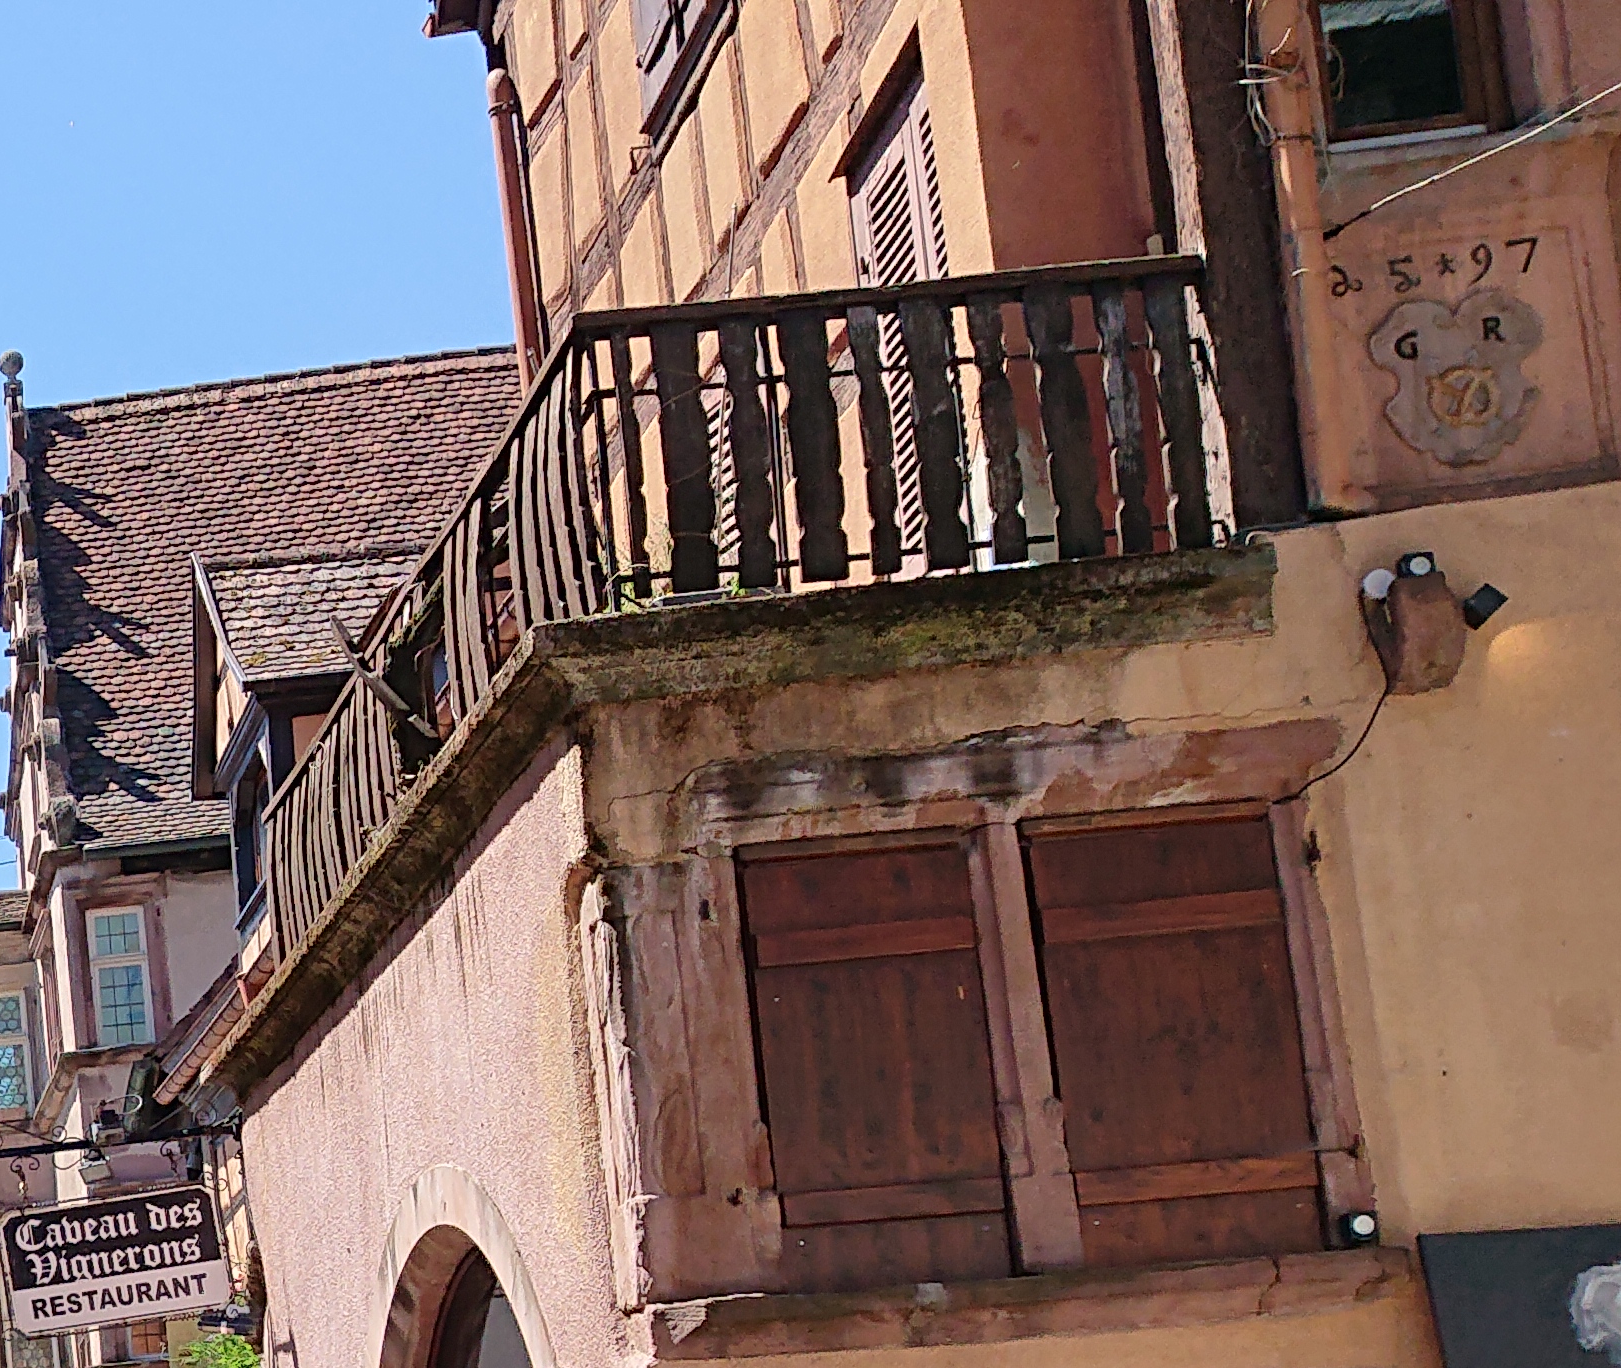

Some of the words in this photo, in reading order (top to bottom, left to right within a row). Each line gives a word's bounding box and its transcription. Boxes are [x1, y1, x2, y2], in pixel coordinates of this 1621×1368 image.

[1393, 329, 1420, 361] G
[1481, 315, 1506, 342] R
[15, 1211, 140, 1252] Caveau
[145, 1198, 204, 1232] des
[26, 1234, 202, 1285] Vignerons
[31, 1272, 208, 1320] RESTAURANT
